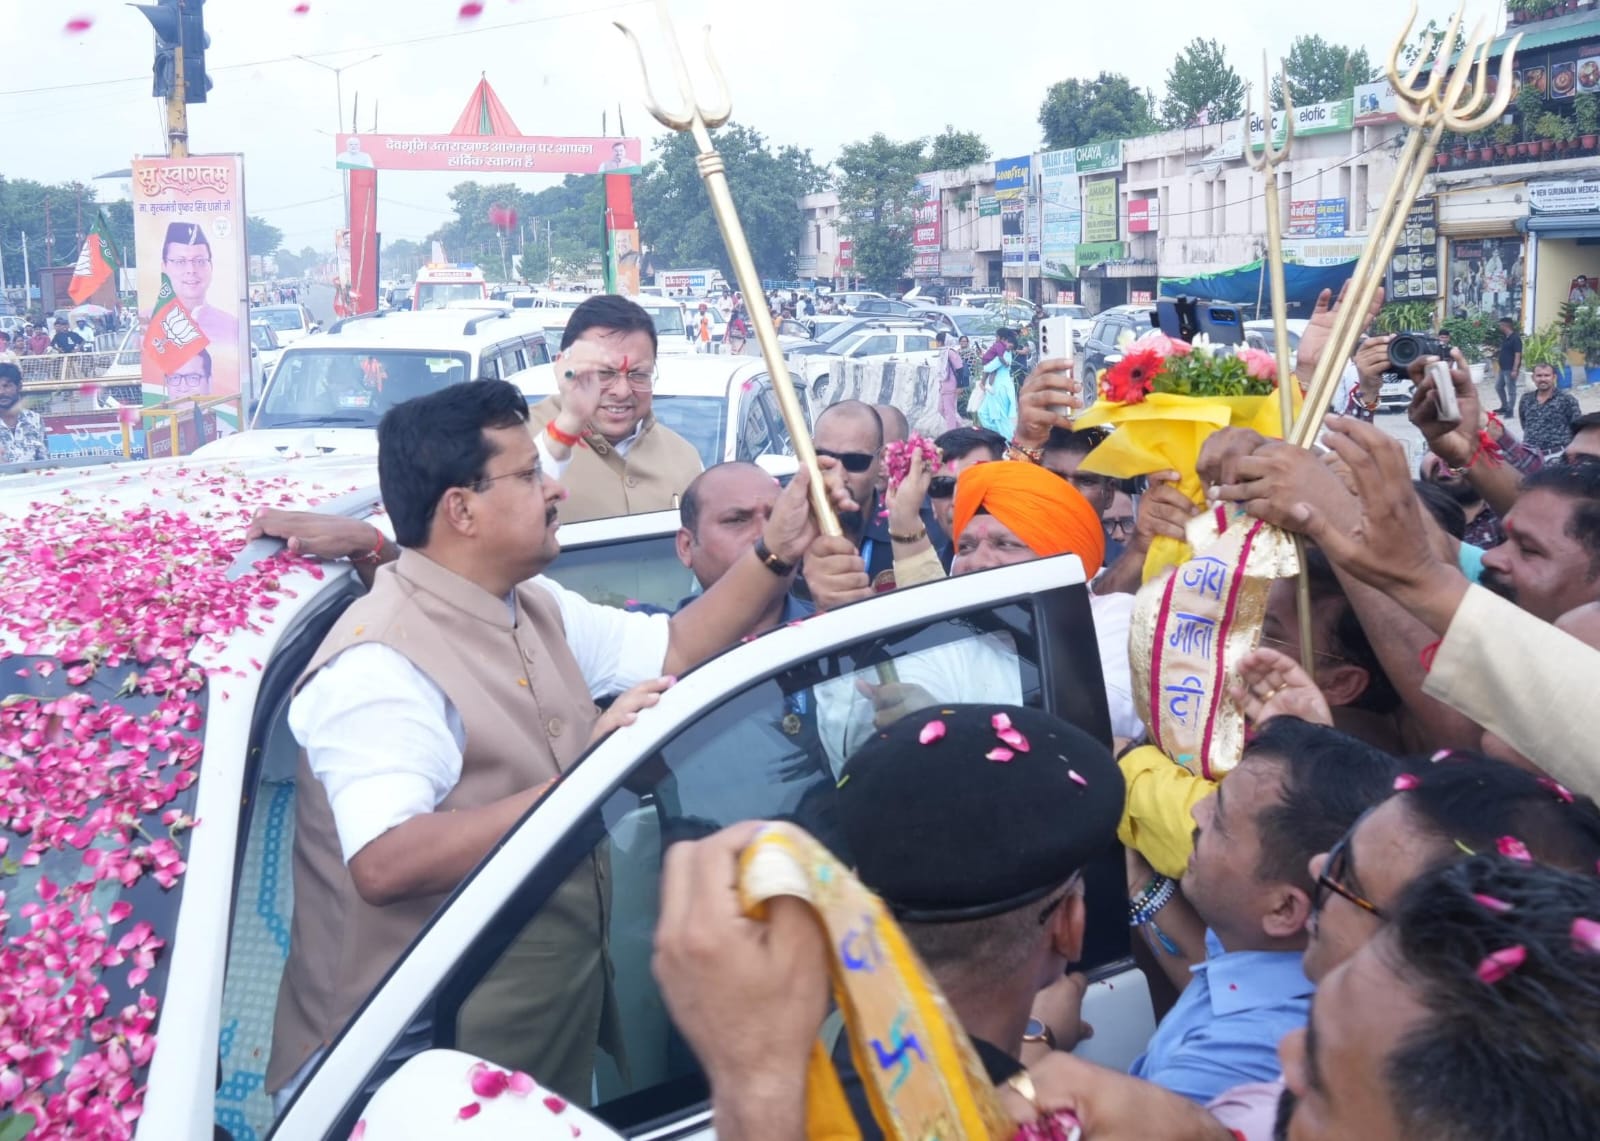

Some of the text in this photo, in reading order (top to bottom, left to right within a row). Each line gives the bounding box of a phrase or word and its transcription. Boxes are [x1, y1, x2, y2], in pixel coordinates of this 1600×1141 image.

[1299, 105, 1326, 122] elofic
[386, 137, 428, 154] देवभूमि
[538, 143, 553, 154] पर
[555, 143, 593, 154] आपका
[1076, 145, 1102, 162] OKAYA
[448, 154, 484, 167] हार्दिक
[487, 156, 522, 167] स्वागत
[1183, 556, 1229, 600] जय
[1170, 613, 1216, 659] माता
[1164, 676, 1205, 732] दी
